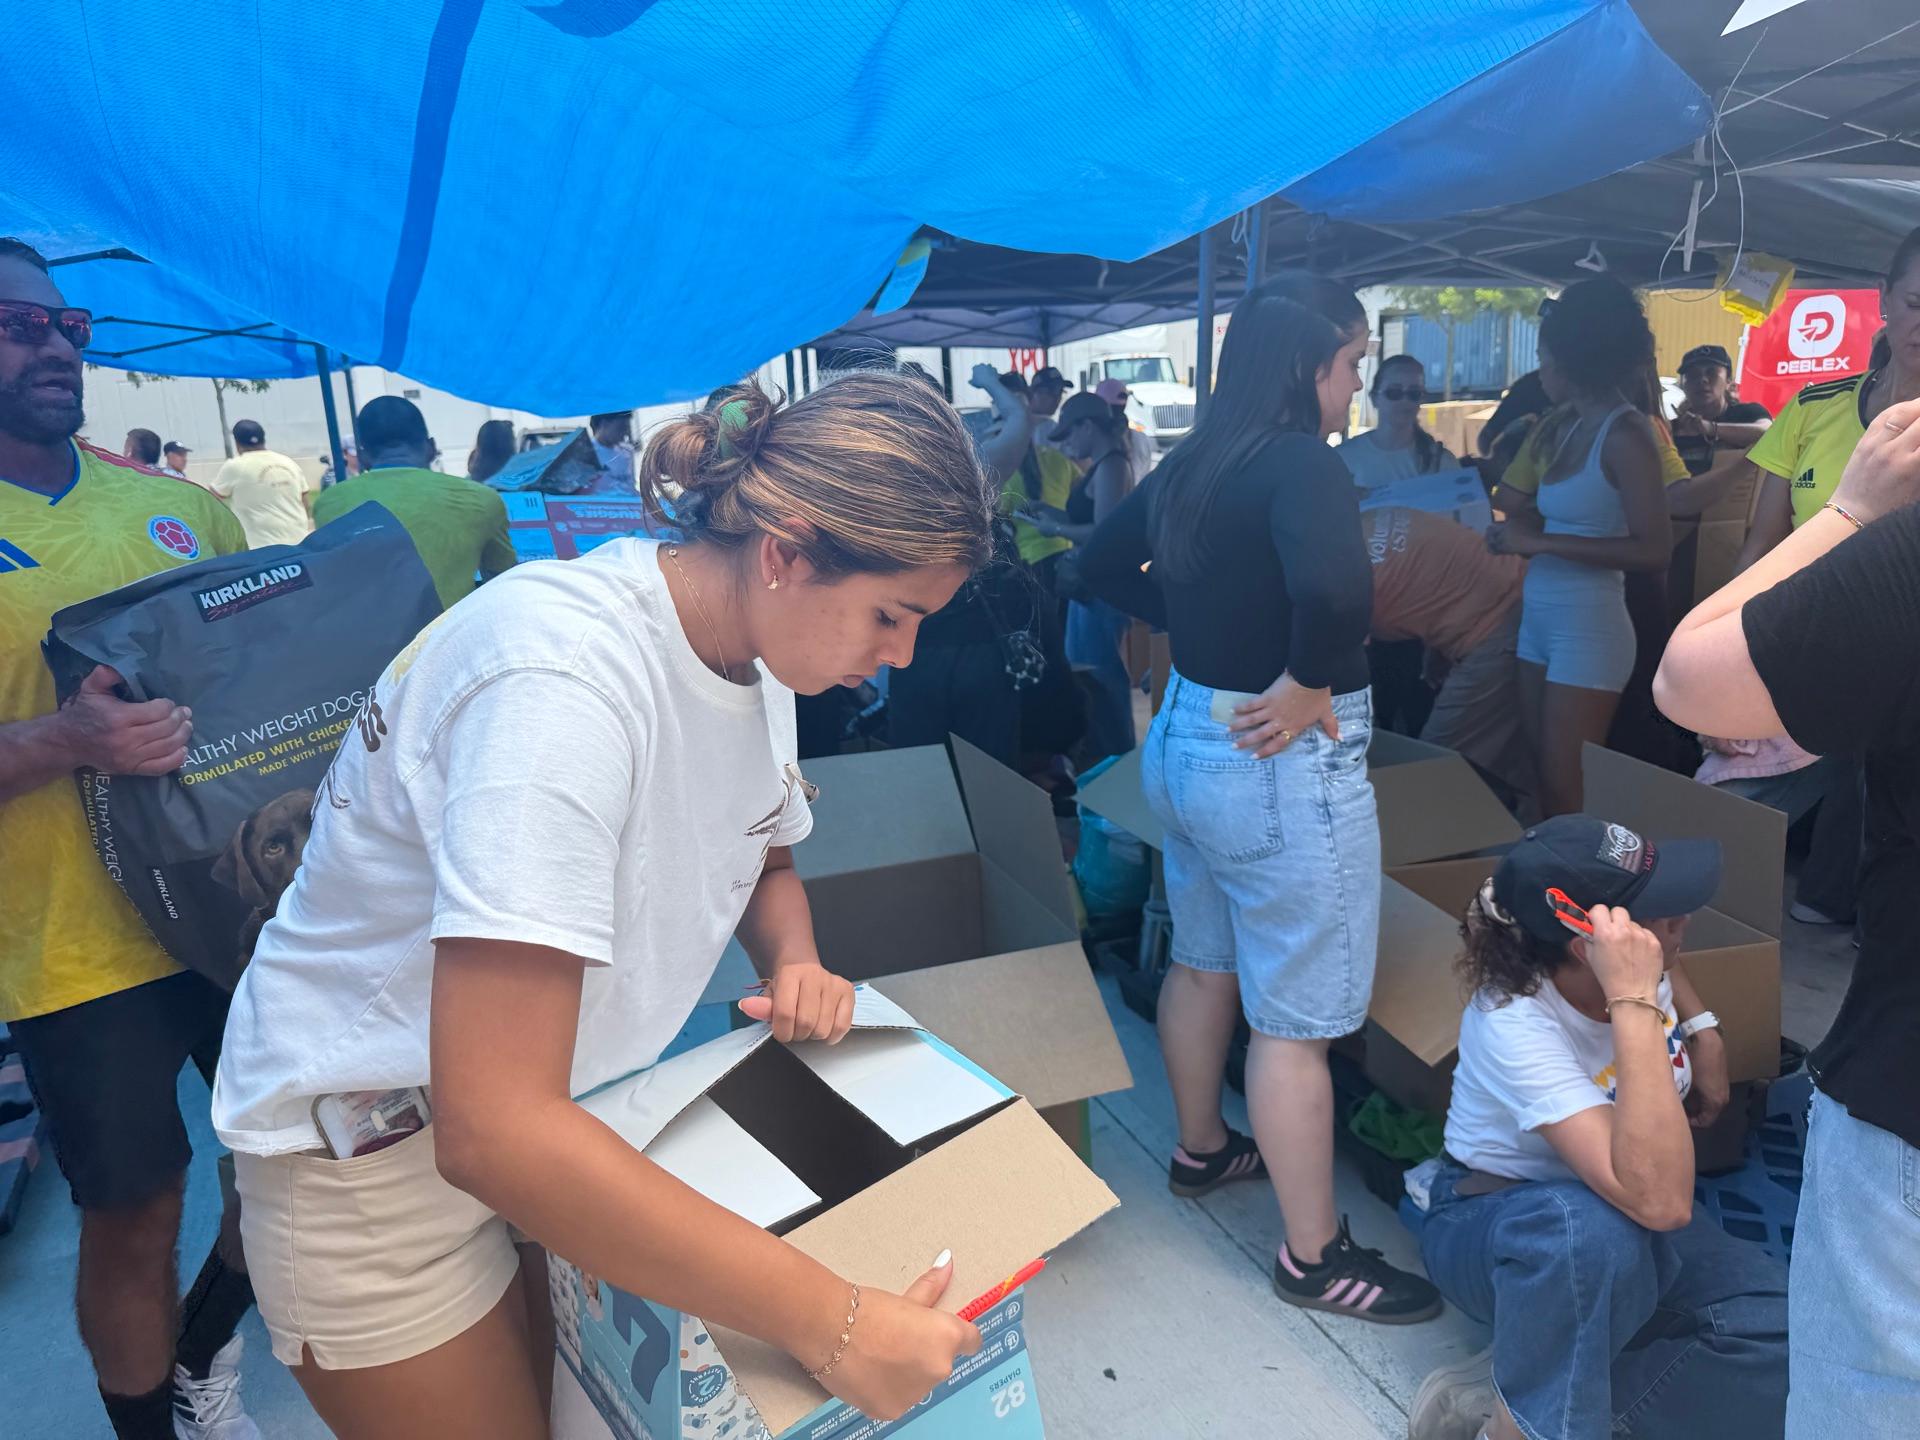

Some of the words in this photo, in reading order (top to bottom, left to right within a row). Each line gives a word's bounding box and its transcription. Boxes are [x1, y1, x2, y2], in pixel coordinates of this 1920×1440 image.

[1776, 357, 1850, 375] DEBLEX
[199, 564, 302, 609] KIRKLAND
[180, 734, 237, 768] ALTHY
[241, 706, 318, 745] WEIGHT
[322, 691, 366, 718] DOG
[259, 760, 288, 776] MADE
[290, 749, 316, 764] WITH
[318, 738, 343, 754] FRES
[269, 737, 304, 756] WITH
[152, 868, 178, 920] KIRKLAND
[990, 1347, 1003, 1359] LEAK
[961, 1355, 991, 1376] PROTECTION
[698, 1374, 715, 1396] 2
[947, 1373, 962, 1386] WITH
[989, 1367, 1021, 1393] DIAPERS
[991, 1379, 1026, 1418] 82
